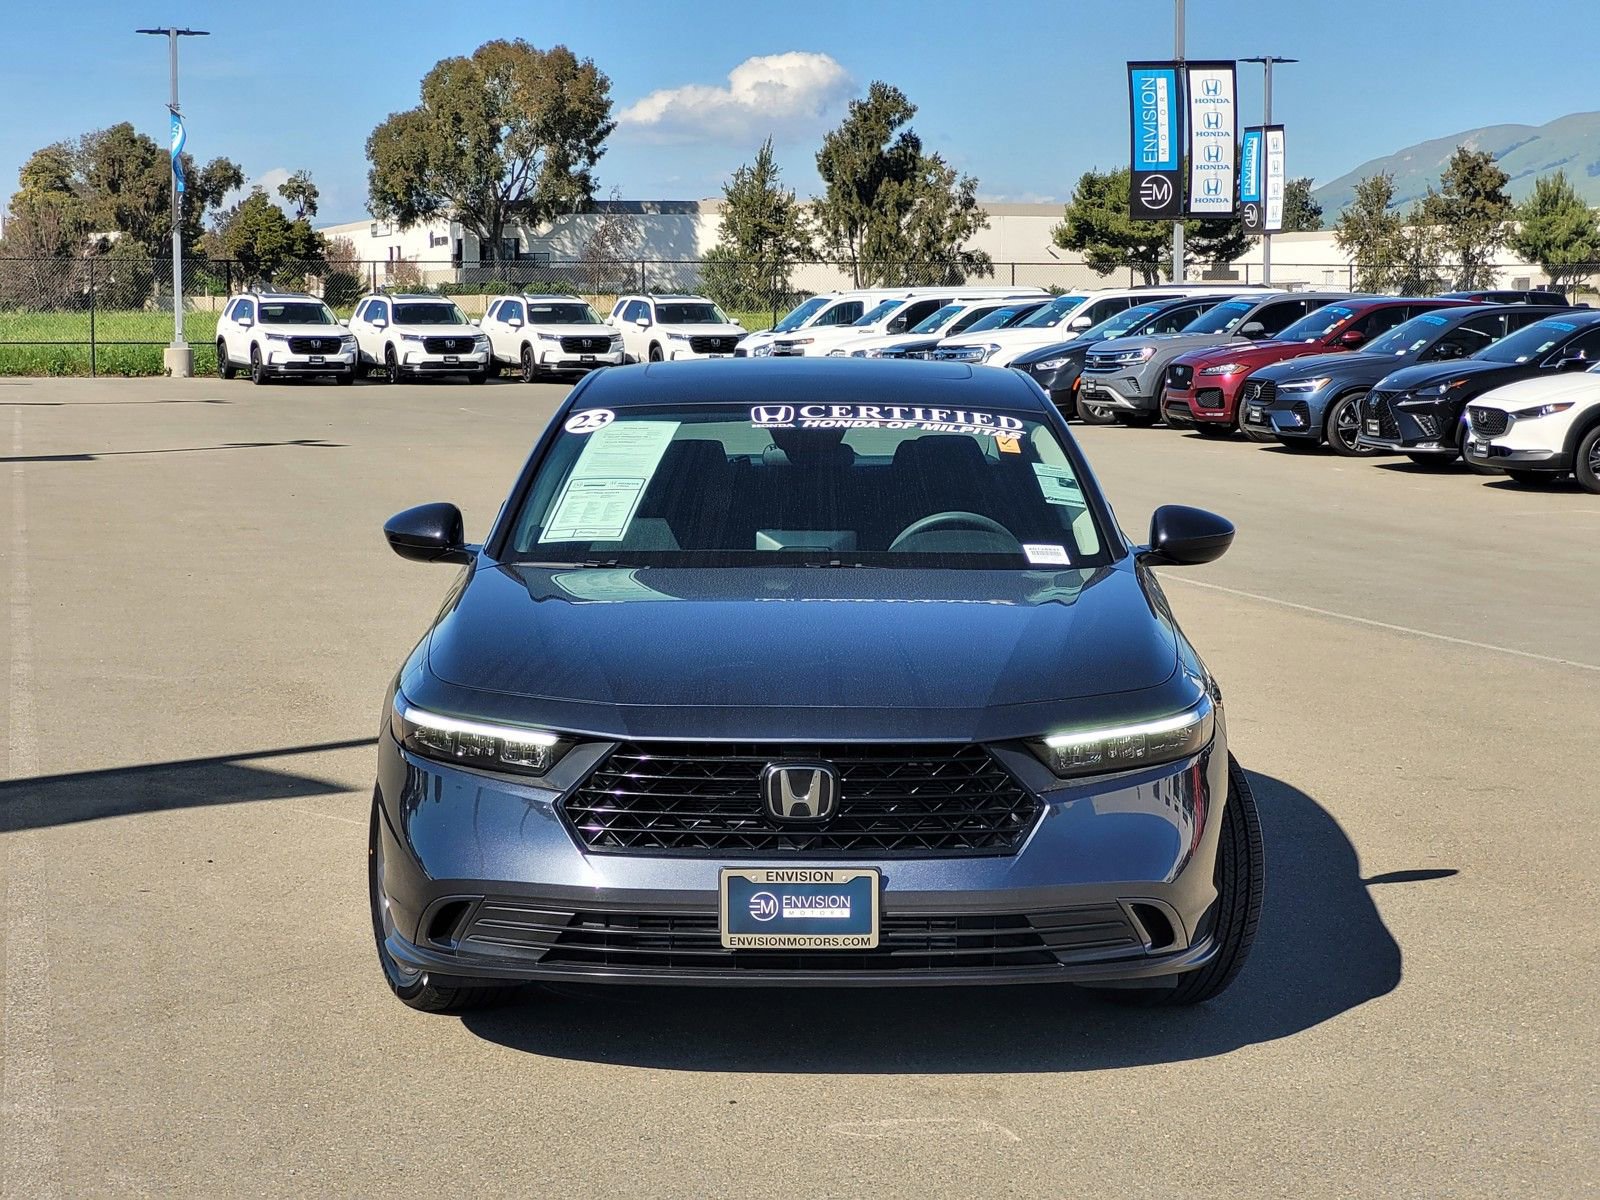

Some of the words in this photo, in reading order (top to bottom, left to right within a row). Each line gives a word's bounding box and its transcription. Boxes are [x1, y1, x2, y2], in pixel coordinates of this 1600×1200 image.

[1141, 77, 1157, 163] ENVISION
[1158, 85, 1167, 156] MOTORS
[1244, 137, 1254, 196] ENVISION
[570, 413, 609, 429] 23
[800, 404, 1024, 430] CERTIFIED
[802, 420, 880, 428] HONDA
[919, 422, 1023, 440] MILPITAS
[766, 871, 834, 882] ENVISION
[782, 895, 851, 908] ENVISION
[729, 936, 871, 946] ENVISIONMOTORS.COM
